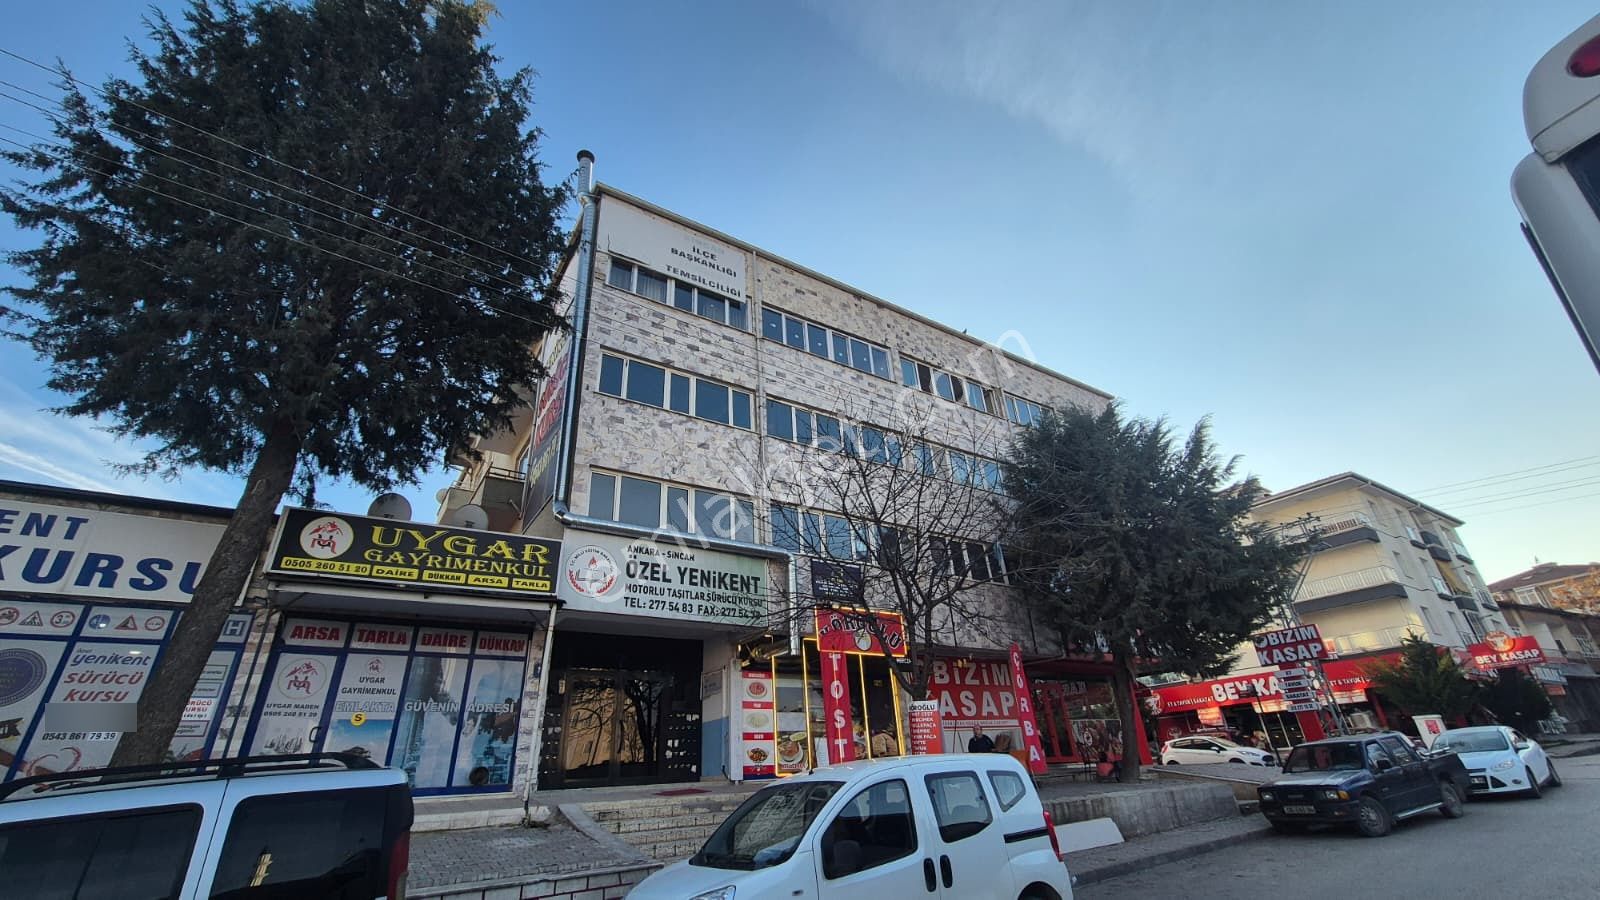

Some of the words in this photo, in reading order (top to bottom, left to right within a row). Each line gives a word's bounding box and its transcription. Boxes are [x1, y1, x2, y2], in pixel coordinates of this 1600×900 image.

[371, 525, 551, 565] UYGAR
[627, 544, 661, 558] ANKARA
[666, 551, 695, 562] SİNCAN
[284, 558, 313, 568] 0505
[315, 561, 336, 571] 260
[338, 564, 352, 573] 51
[353, 565, 368, 574] 20
[363, 549, 550, 578] GAYRİMENKUL
[375, 568, 416, 578] DAİRE
[472, 577, 505, 585] ARSA
[626, 555, 672, 583] ÖZEL
[677, 566, 761, 594] YENİKENT
[514, 580, 550, 590] TARLA
[625, 584, 665, 597] MOTORLU
[666, 587, 706, 601] TAŞITLAR
[706, 591, 737, 604] SÜRÜCÜ
[624, 597, 647, 609] TEL:
[648, 600, 667, 611] 277
[667, 602, 680, 613] 54
[682, 603, 693, 613] 83
[290, 625, 341, 641] ARSA
[357, 628, 408, 645] TARLA
[420, 632, 468, 648] DAİRE
[70, 652, 151, 667] yenikent
[1258, 642, 1322, 665] KASAP
[1474, 653, 1497, 665] BEY
[1499, 648, 1541, 661] KASAP
[358, 676, 386, 685] UYGAR
[341, 684, 397, 696] GAYRİMENKUL
[334, 700, 396, 713] EMLAKTA
[404, 698, 459, 713] GÜVENİN
[466, 702, 516, 714] ADRESİ
[827, 652, 849, 759] TOST
[926, 689, 1016, 717] ASAP
[42, 732, 67, 741] 0543
[69, 732, 87, 741] 861
[89, 732, 102, 740] 79
[103, 732, 116, 740] 39
